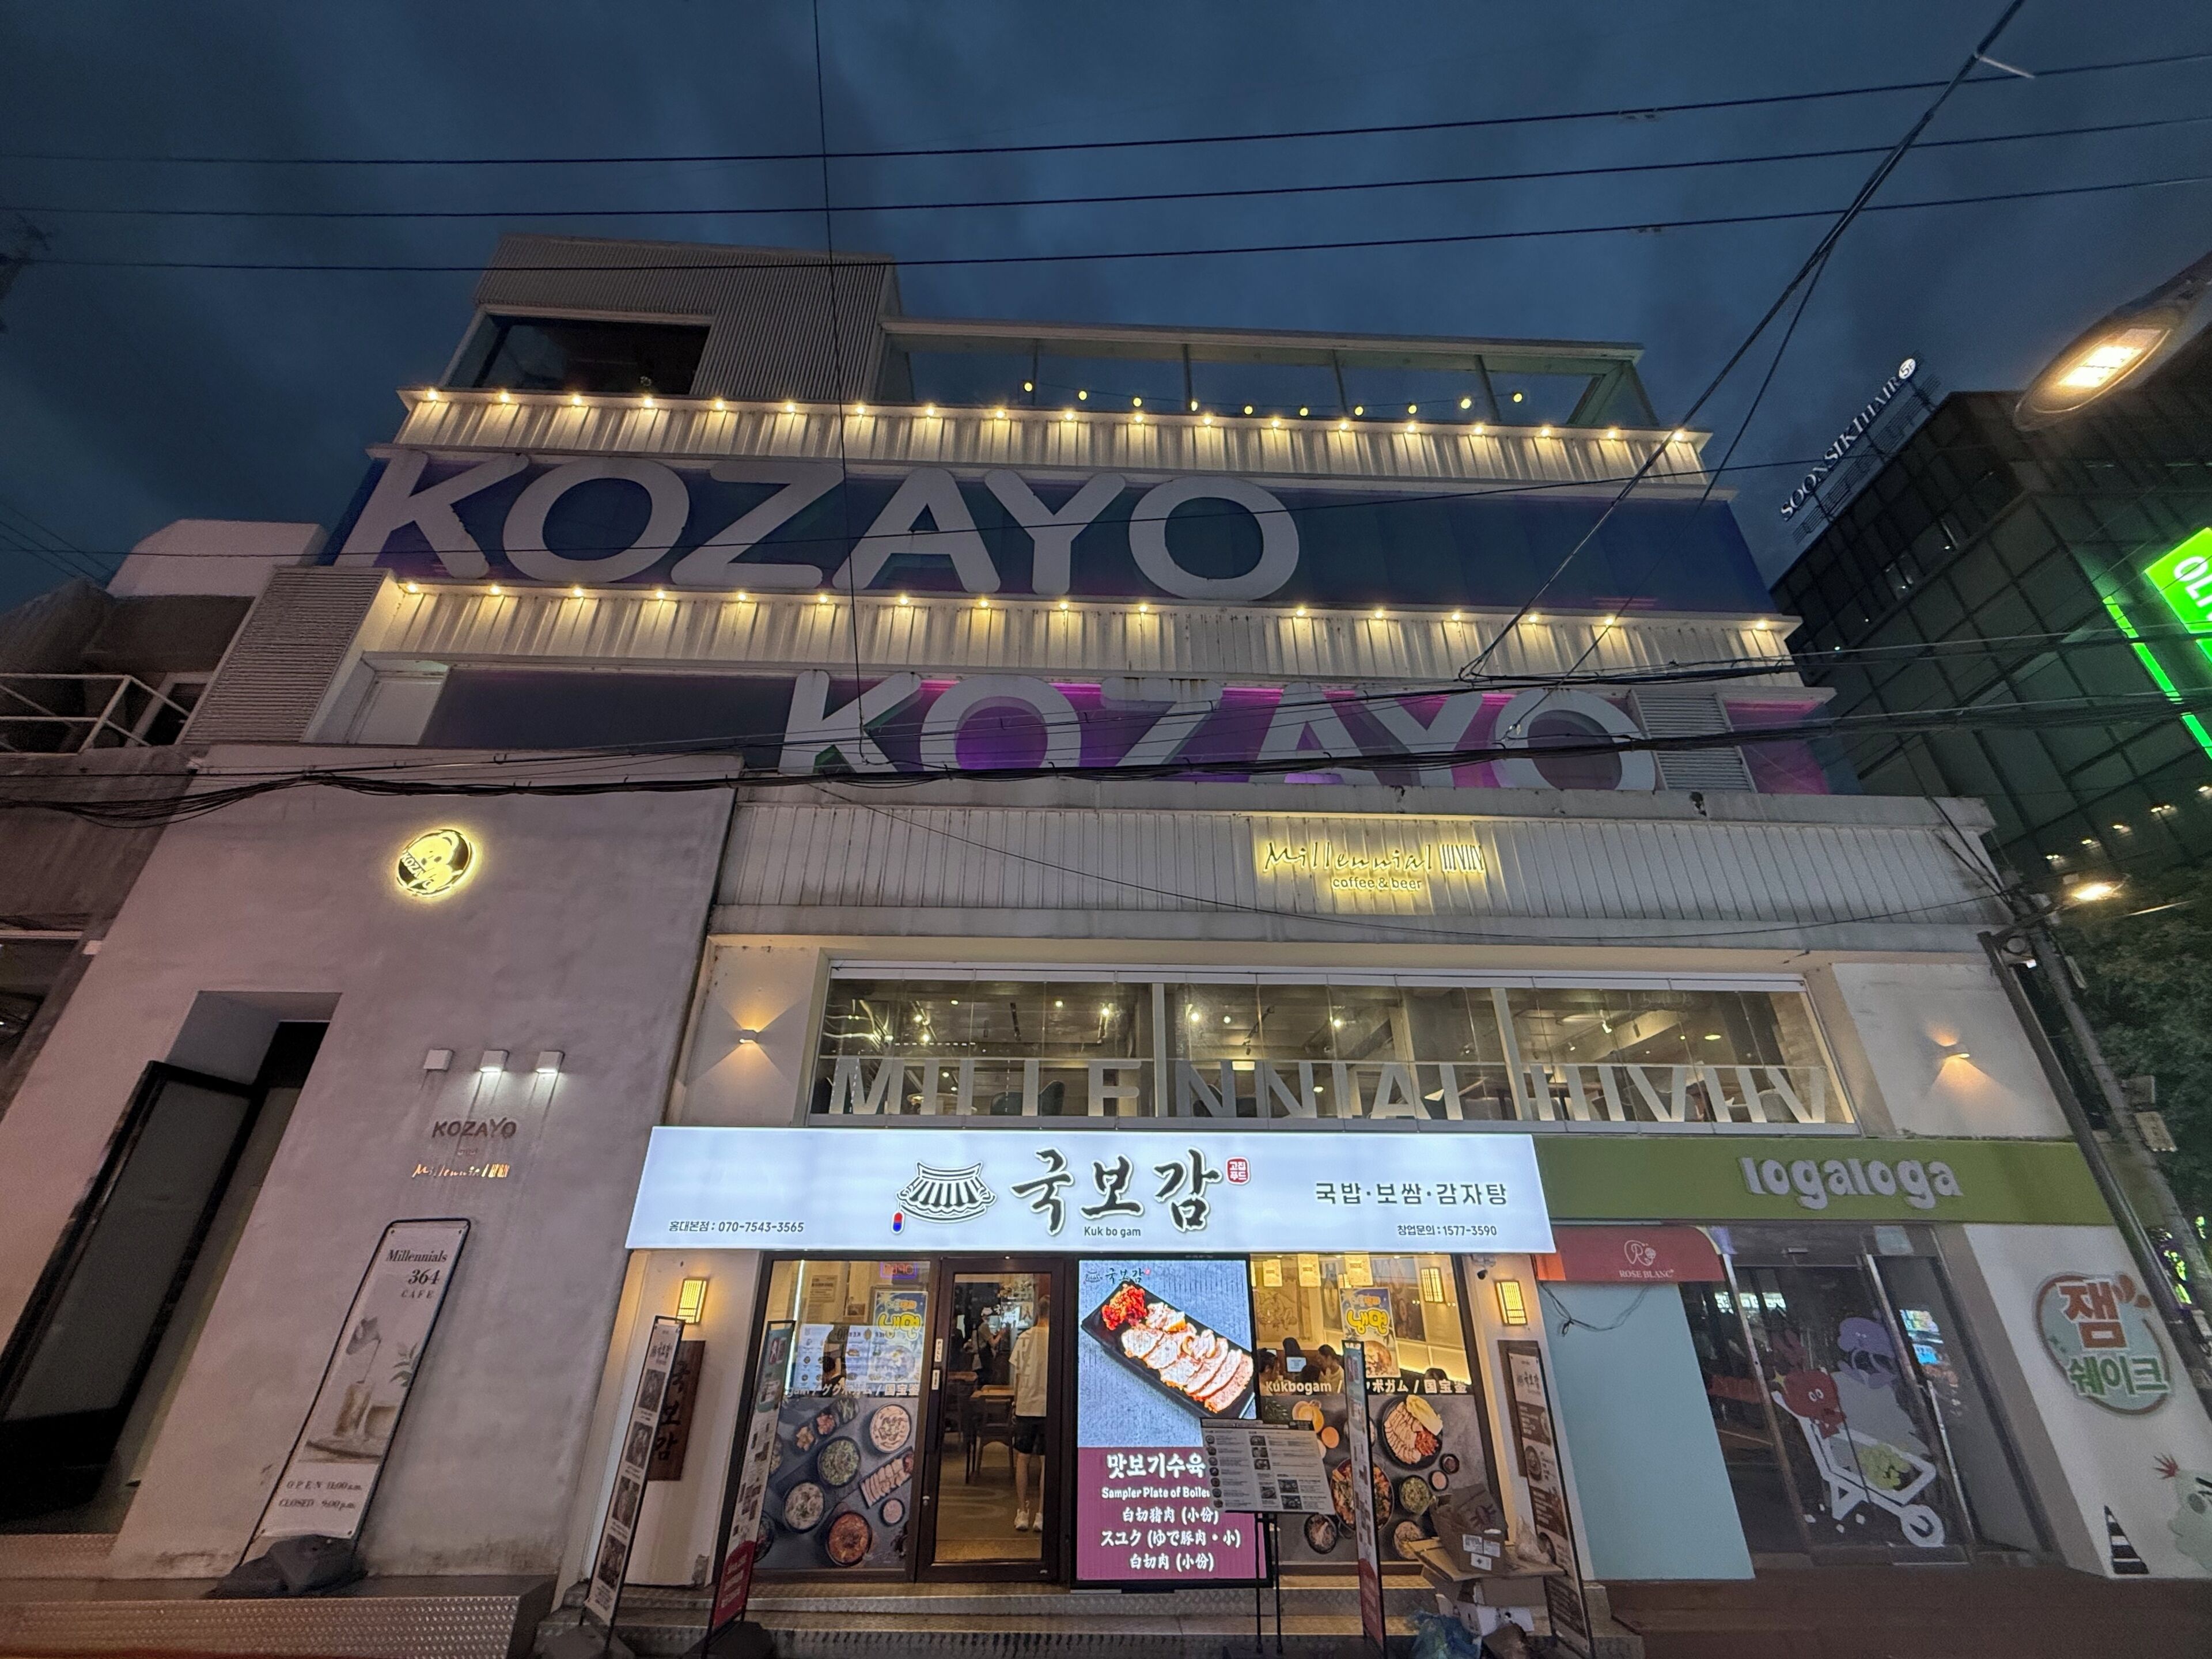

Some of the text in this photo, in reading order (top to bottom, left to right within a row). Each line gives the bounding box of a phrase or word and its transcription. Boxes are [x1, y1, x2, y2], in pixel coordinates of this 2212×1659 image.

[335, 452, 1300, 600] KOZAYO
[778, 670, 1657, 791] KOZAYO
[1264, 840, 1432, 871] Millennial
[1332, 877, 1423, 891] coffee & beer
[431, 1117, 517, 1139] KOZAYO
[1011, 1149, 1220, 1232] 국보감
[1738, 1157, 1964, 1210] logaloga
[718, 1221, 804, 1233] 070-7543-3565
[1084, 1226, 1141, 1238] Kuk bo gam
[1442, 1225, 1497, 1236] 1577-3590
[386, 1249, 448, 1262] Millennials
[408, 1268, 440, 1285] 364
[1105, 1267, 1145, 1284] 국보감
[1619, 1270, 1642, 1278] ROSE
[401, 1290, 434, 1299] CAFE
[2056, 1278, 2128, 1350] 잼
[1266, 1381, 1332, 1395] Kukbogam
[1107, 1453, 1206, 1479] 맛보기수육
[286, 1481, 322, 1489] OPEN
[1101, 1487, 1142, 1500] Sampler
[1143, 1487, 1168, 1498] Plate
[1170, 1486, 1181, 1498] of
[279, 1499, 314, 1508] CLOSED
[1101, 1529, 1142, 1547] スユク
[1130, 1553, 1169, 1570] 白切肉
